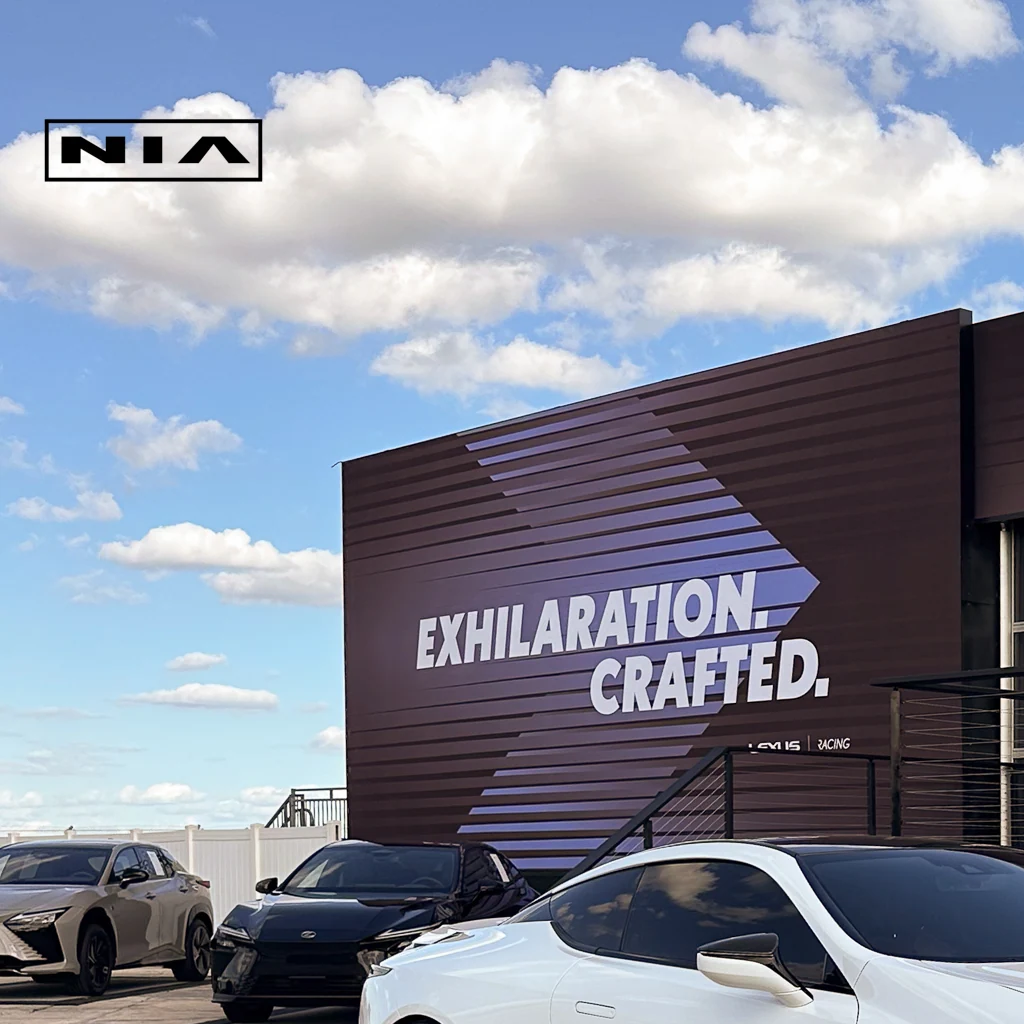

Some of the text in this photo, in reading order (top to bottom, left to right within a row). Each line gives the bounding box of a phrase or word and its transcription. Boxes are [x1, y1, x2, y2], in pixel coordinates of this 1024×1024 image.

[416, 570, 769, 670] EXHILARATION.
[590, 638, 830, 715] CRAFTED.
[748, 738, 850, 754] EXUS RACING
